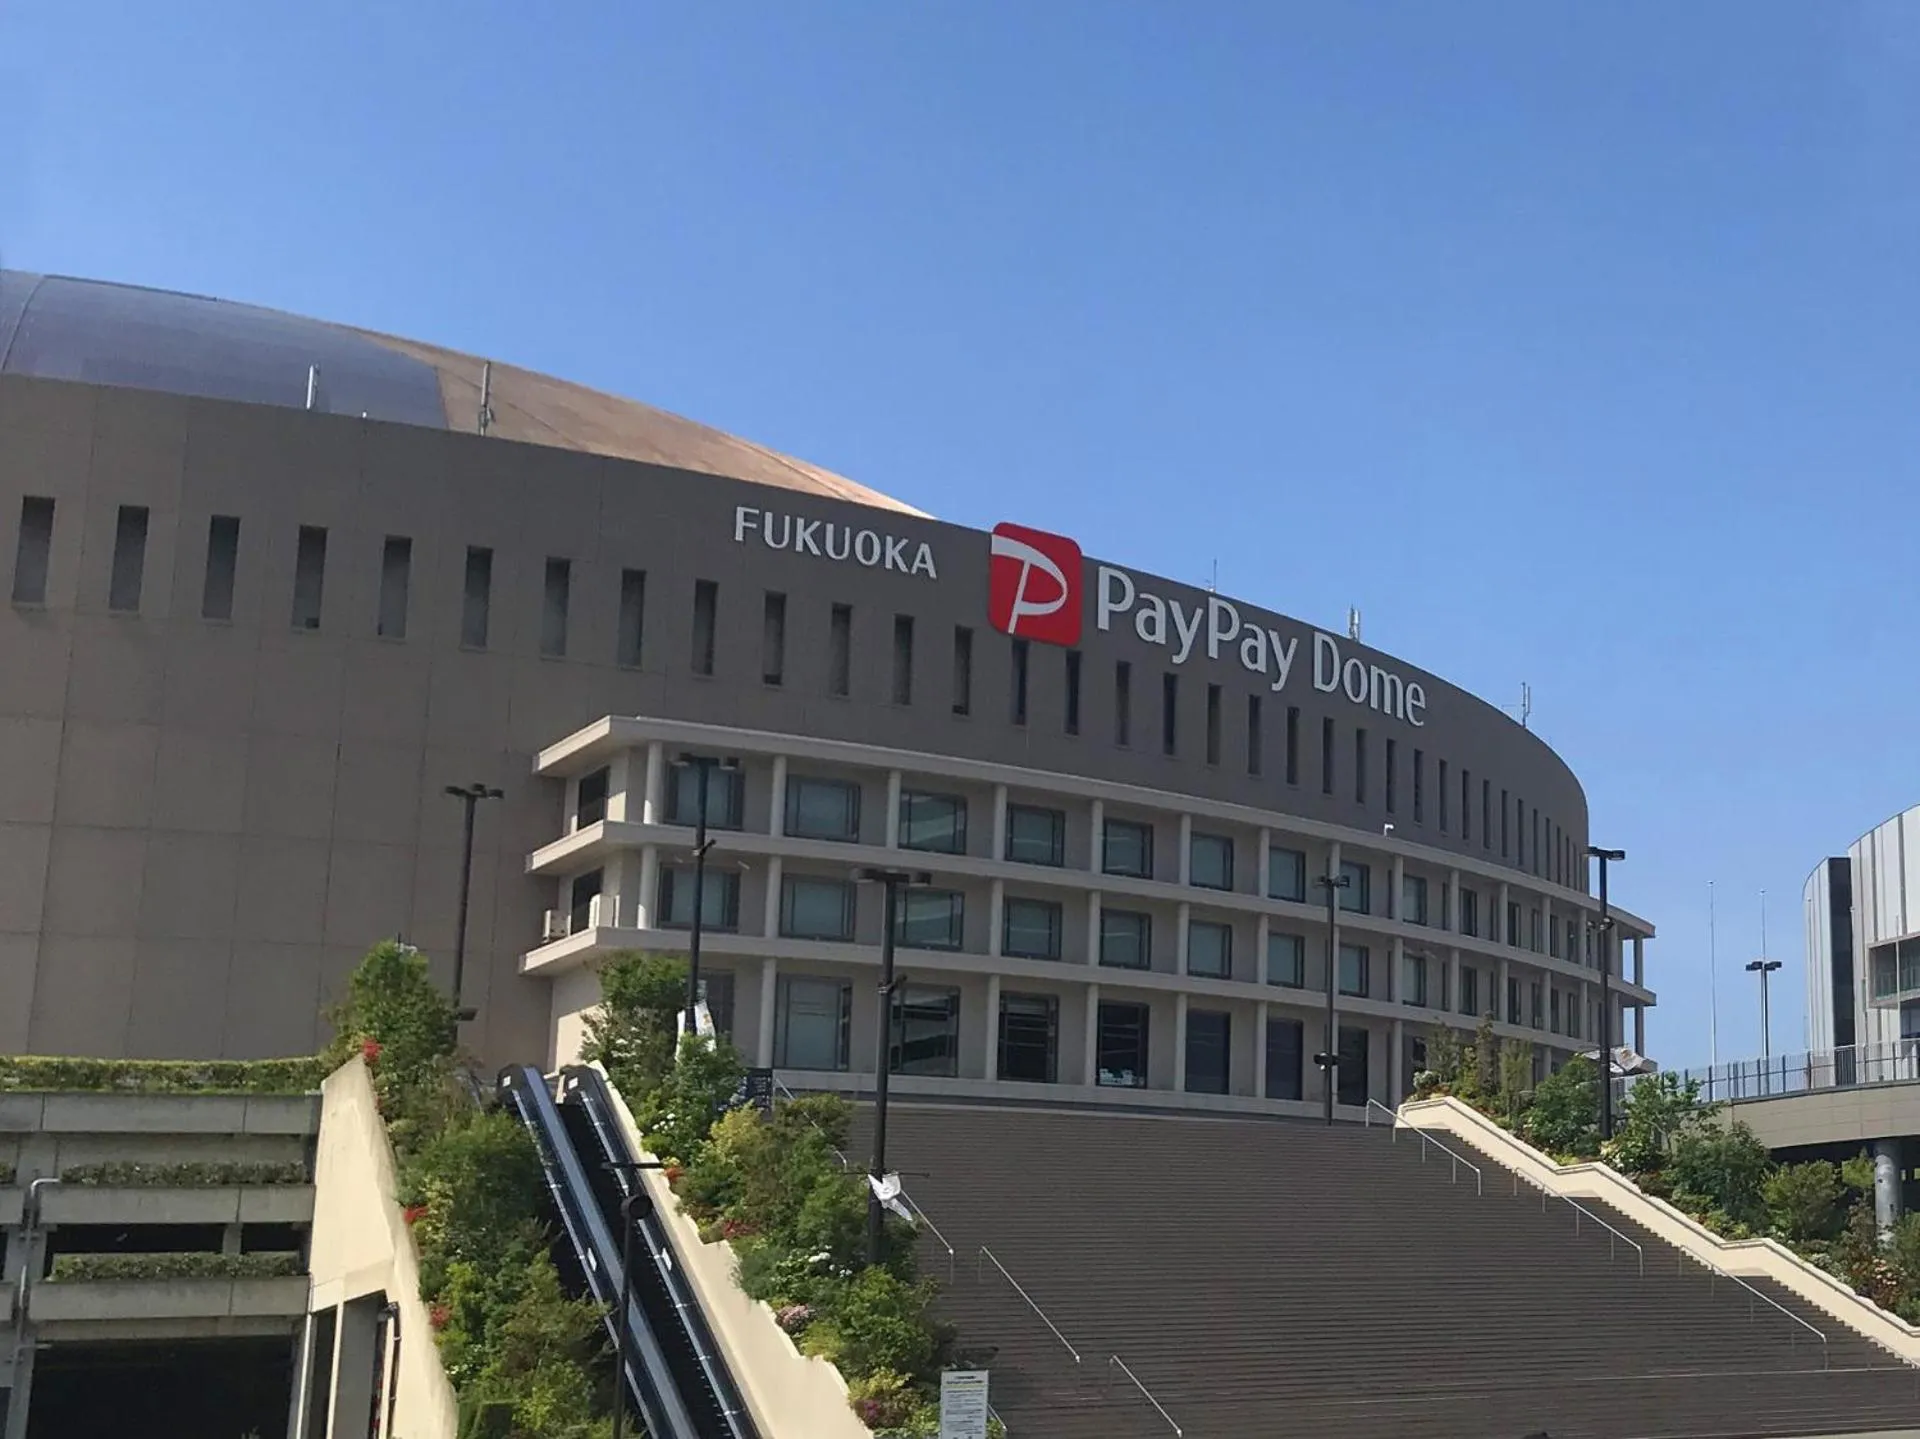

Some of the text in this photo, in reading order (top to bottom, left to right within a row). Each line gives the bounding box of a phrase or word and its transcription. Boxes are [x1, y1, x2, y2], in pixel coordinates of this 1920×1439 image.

[734, 506, 938, 579] FUKUOKA
[1096, 566, 1427, 727] PayPay Dome
